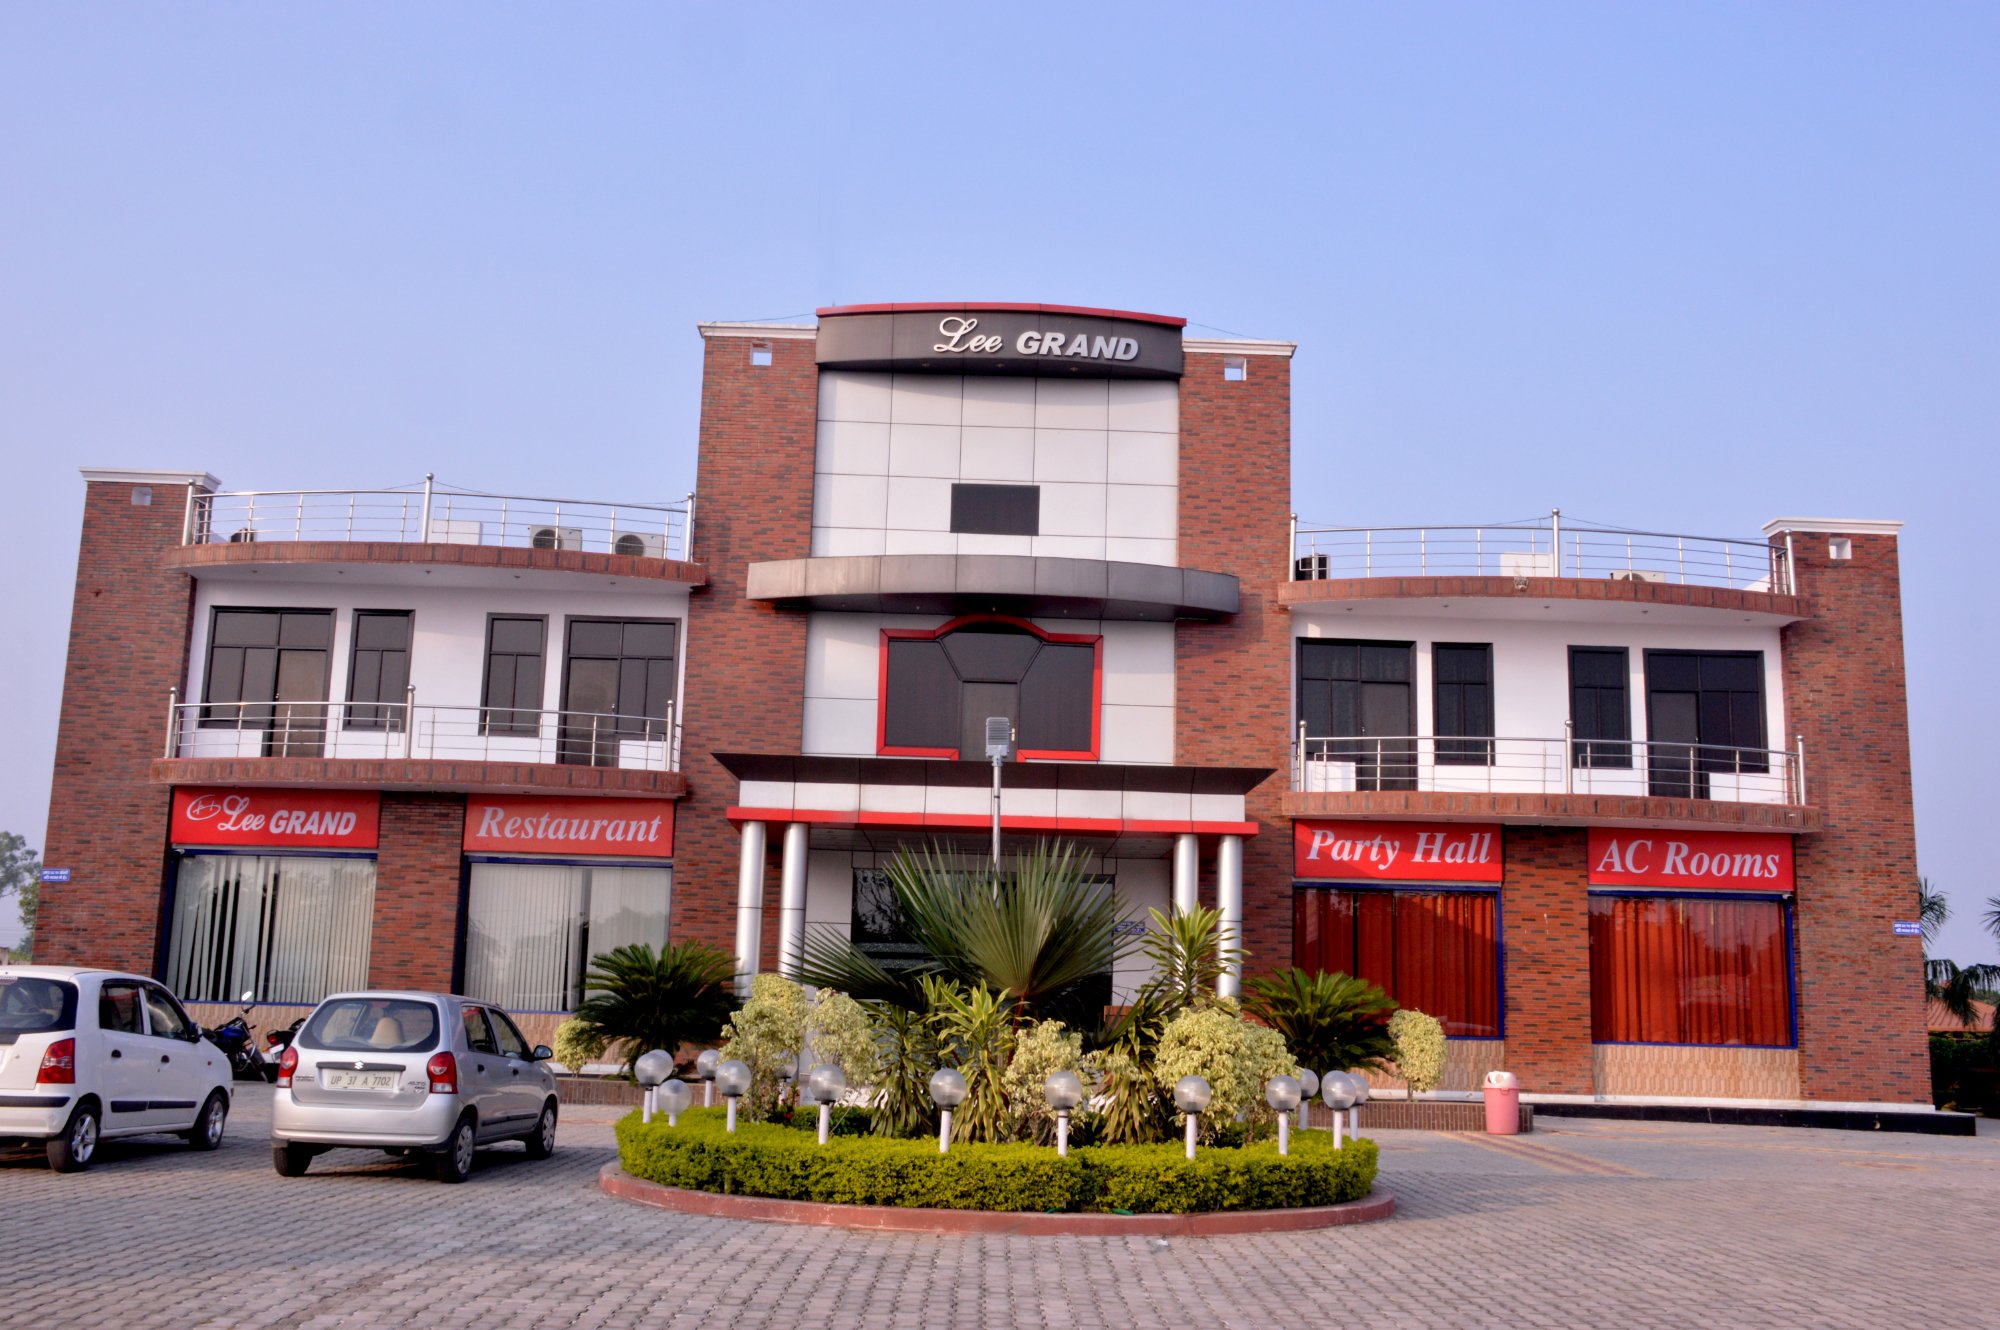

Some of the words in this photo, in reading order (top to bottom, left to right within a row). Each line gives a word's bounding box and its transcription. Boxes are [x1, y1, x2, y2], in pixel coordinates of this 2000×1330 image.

[933, 316, 1003, 353] Lee
[1016, 331, 1138, 361] GRAND
[217, 795, 265, 831] Lee
[269, 810, 356, 835] GRAND
[476, 806, 662, 842] Restaurant
[1306, 829, 1400, 870] Party
[1411, 832, 1490, 863] Hall
[1596, 838, 1653, 874] AC
[1661, 841, 1780, 878] Rooms
[330, 1075, 342, 1085] UP
[347, 1076, 357, 1085] 37
